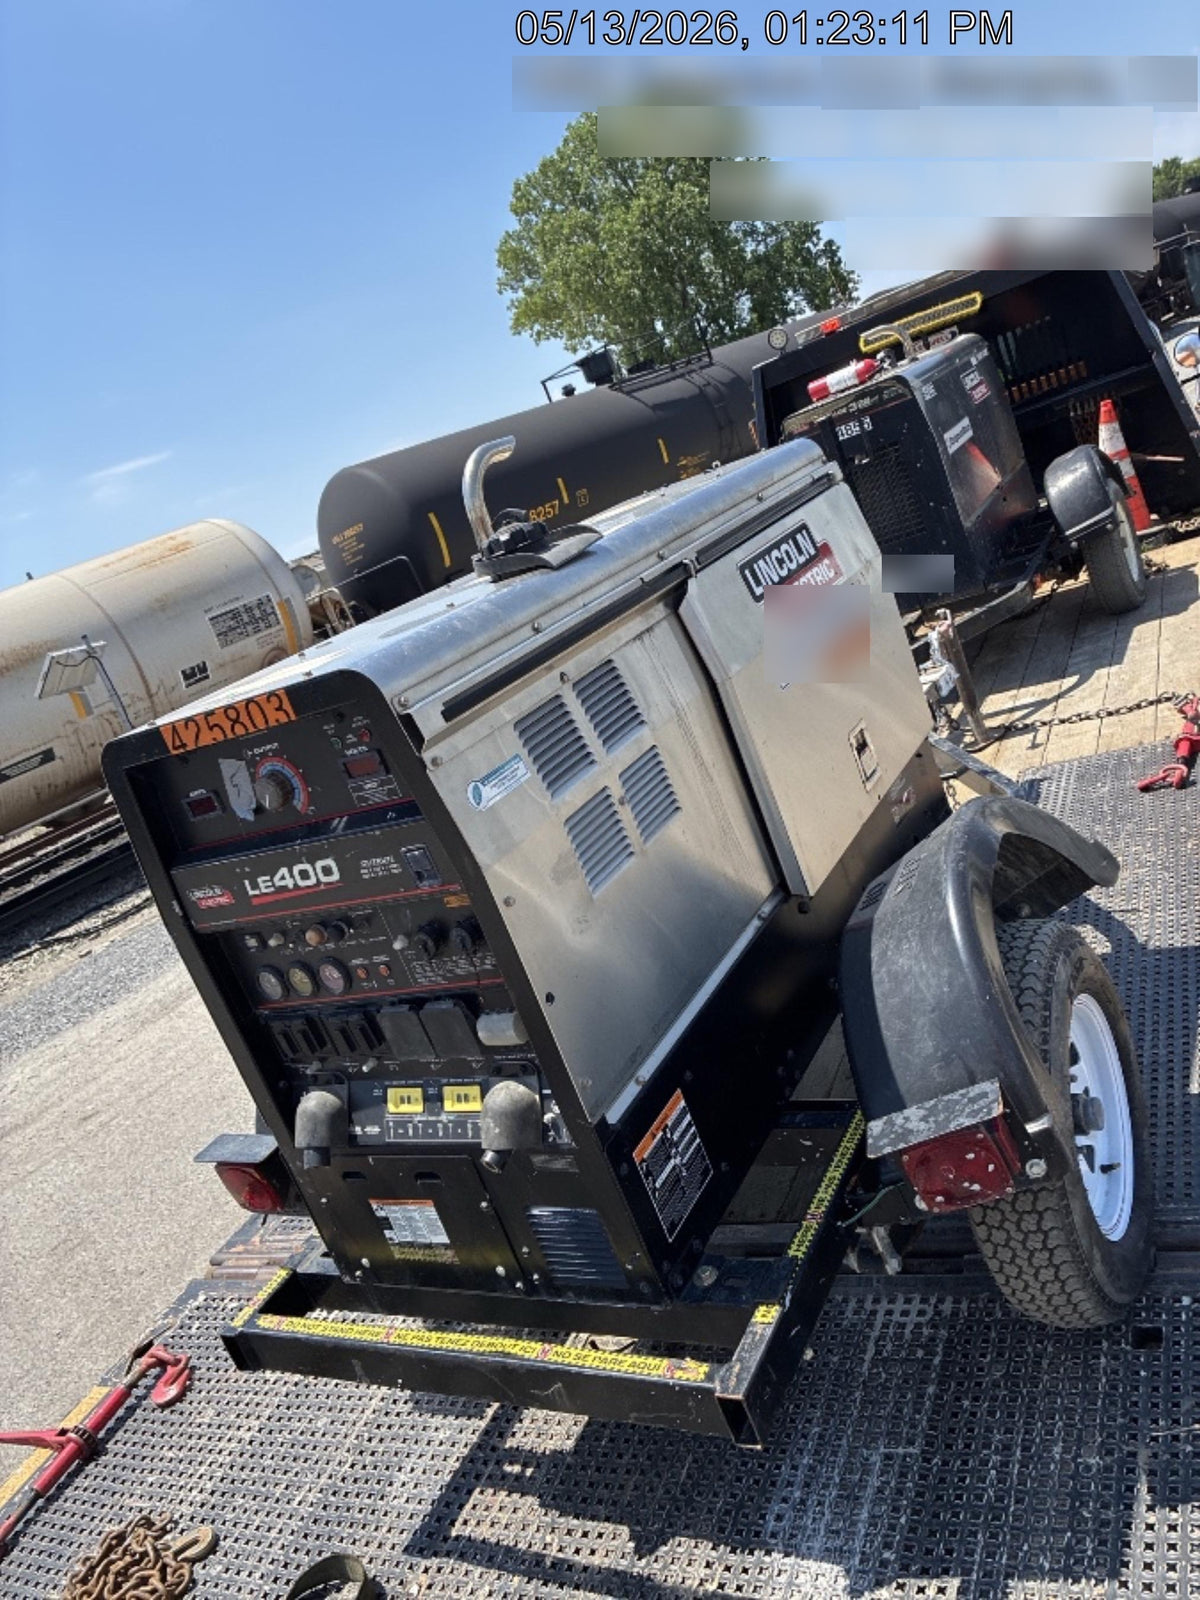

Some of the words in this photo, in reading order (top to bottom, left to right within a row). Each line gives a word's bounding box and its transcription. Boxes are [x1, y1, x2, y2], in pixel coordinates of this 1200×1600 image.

[744, 529, 817, 596] LINCOLN
[171, 692, 291, 751] 425803
[243, 857, 340, 896] LE400
[552, 1350, 571, 1359] NO
[572, 1352, 591, 1362] SE
